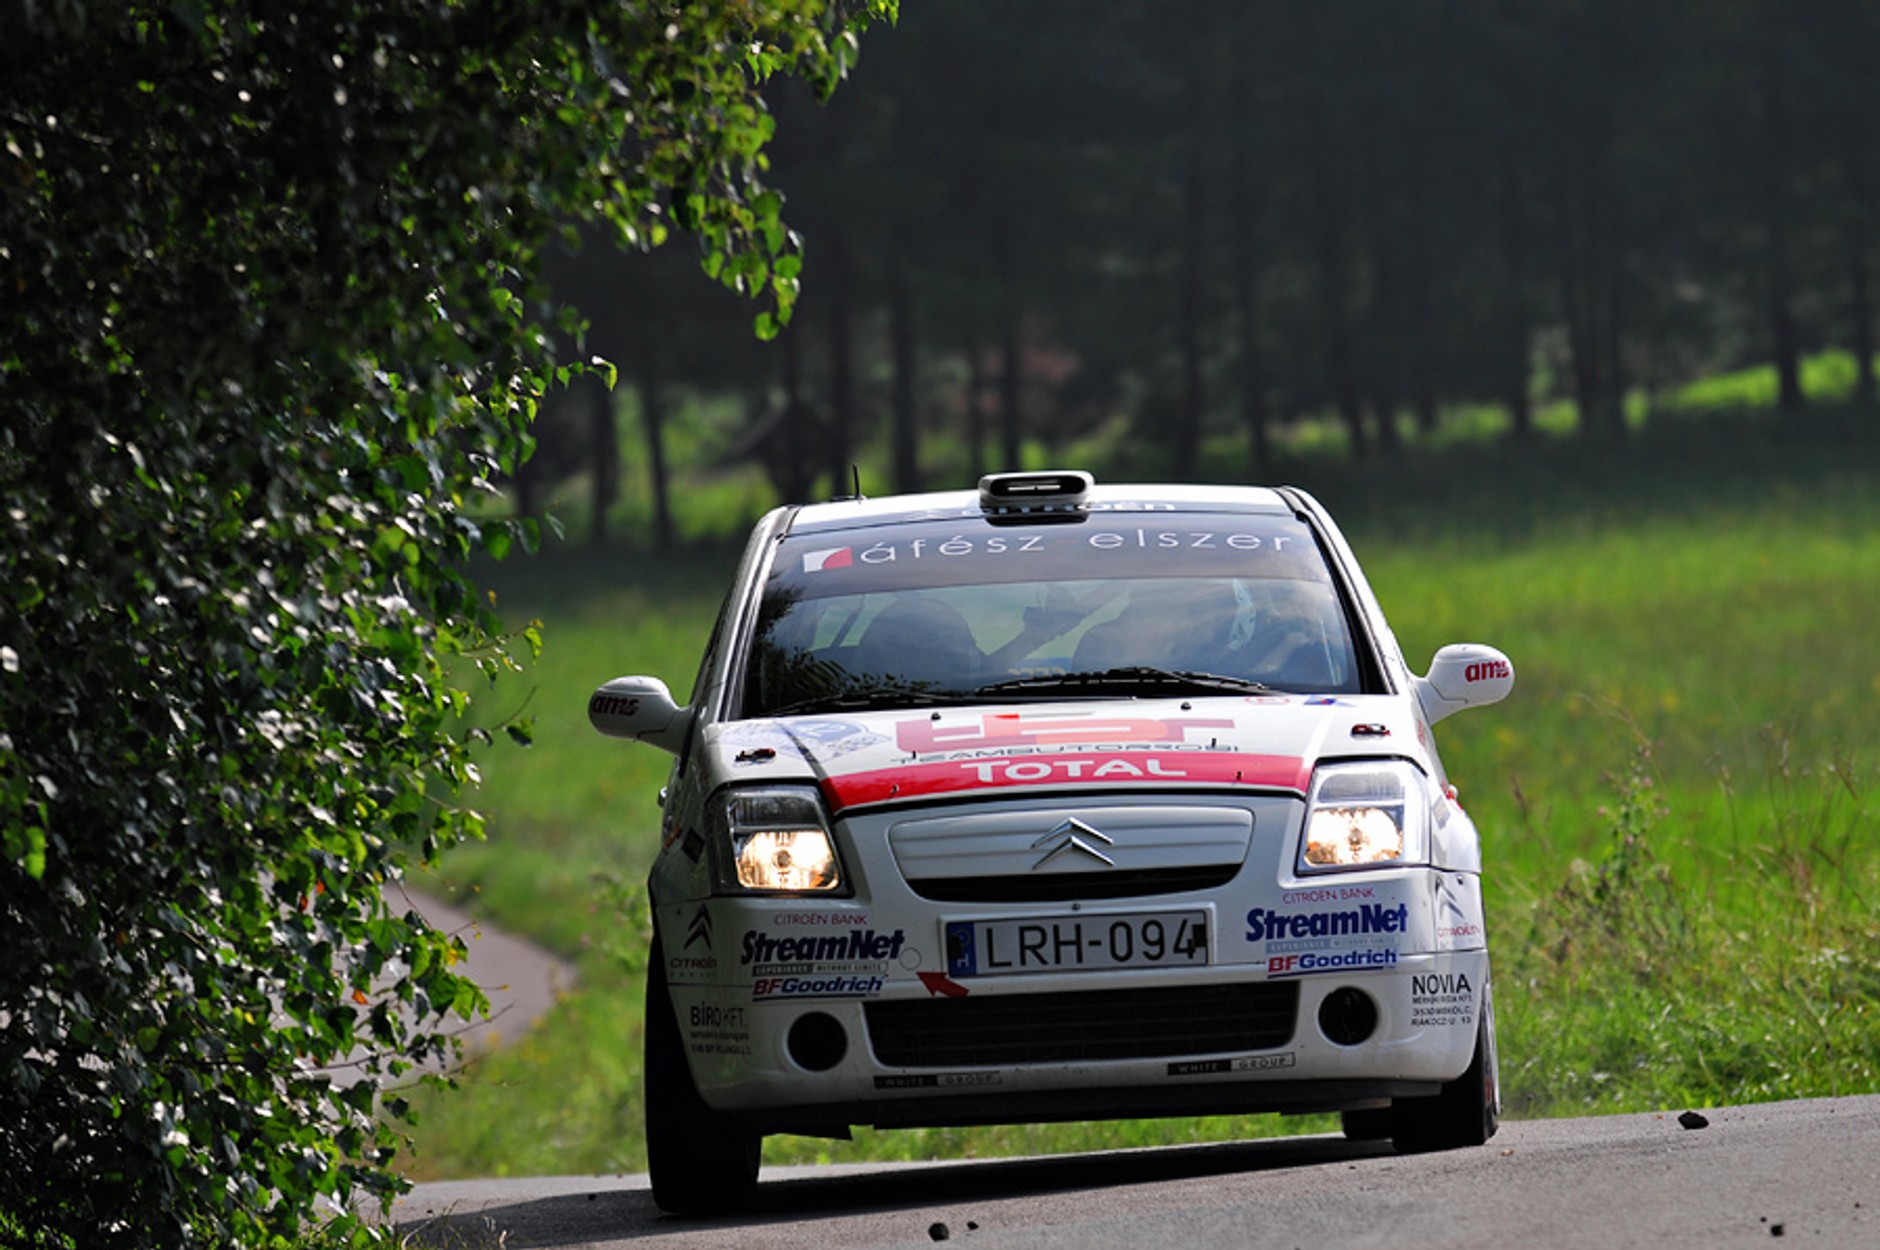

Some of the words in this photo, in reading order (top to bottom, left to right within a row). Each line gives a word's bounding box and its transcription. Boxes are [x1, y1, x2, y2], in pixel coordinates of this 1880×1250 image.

[860, 533, 1044, 563] áfész
[1090, 529, 1292, 552] elszer
[1464, 660, 1510, 683] ams
[960, 758, 1187, 782] TOTAL
[1341, 887, 1376, 899] BANK
[831, 912, 868, 925] BANK
[1246, 903, 1408, 941] StreamNet
[742, 930, 904, 966] StreamNet
[985, 918, 1197, 968] LRH-094
[1267, 948, 1397, 973] BFGoodrich
[752, 974, 884, 996] BFGoodrich
[1412, 973, 1472, 995] NOVIA
[1238, 1056, 1287, 1069] GROUP
